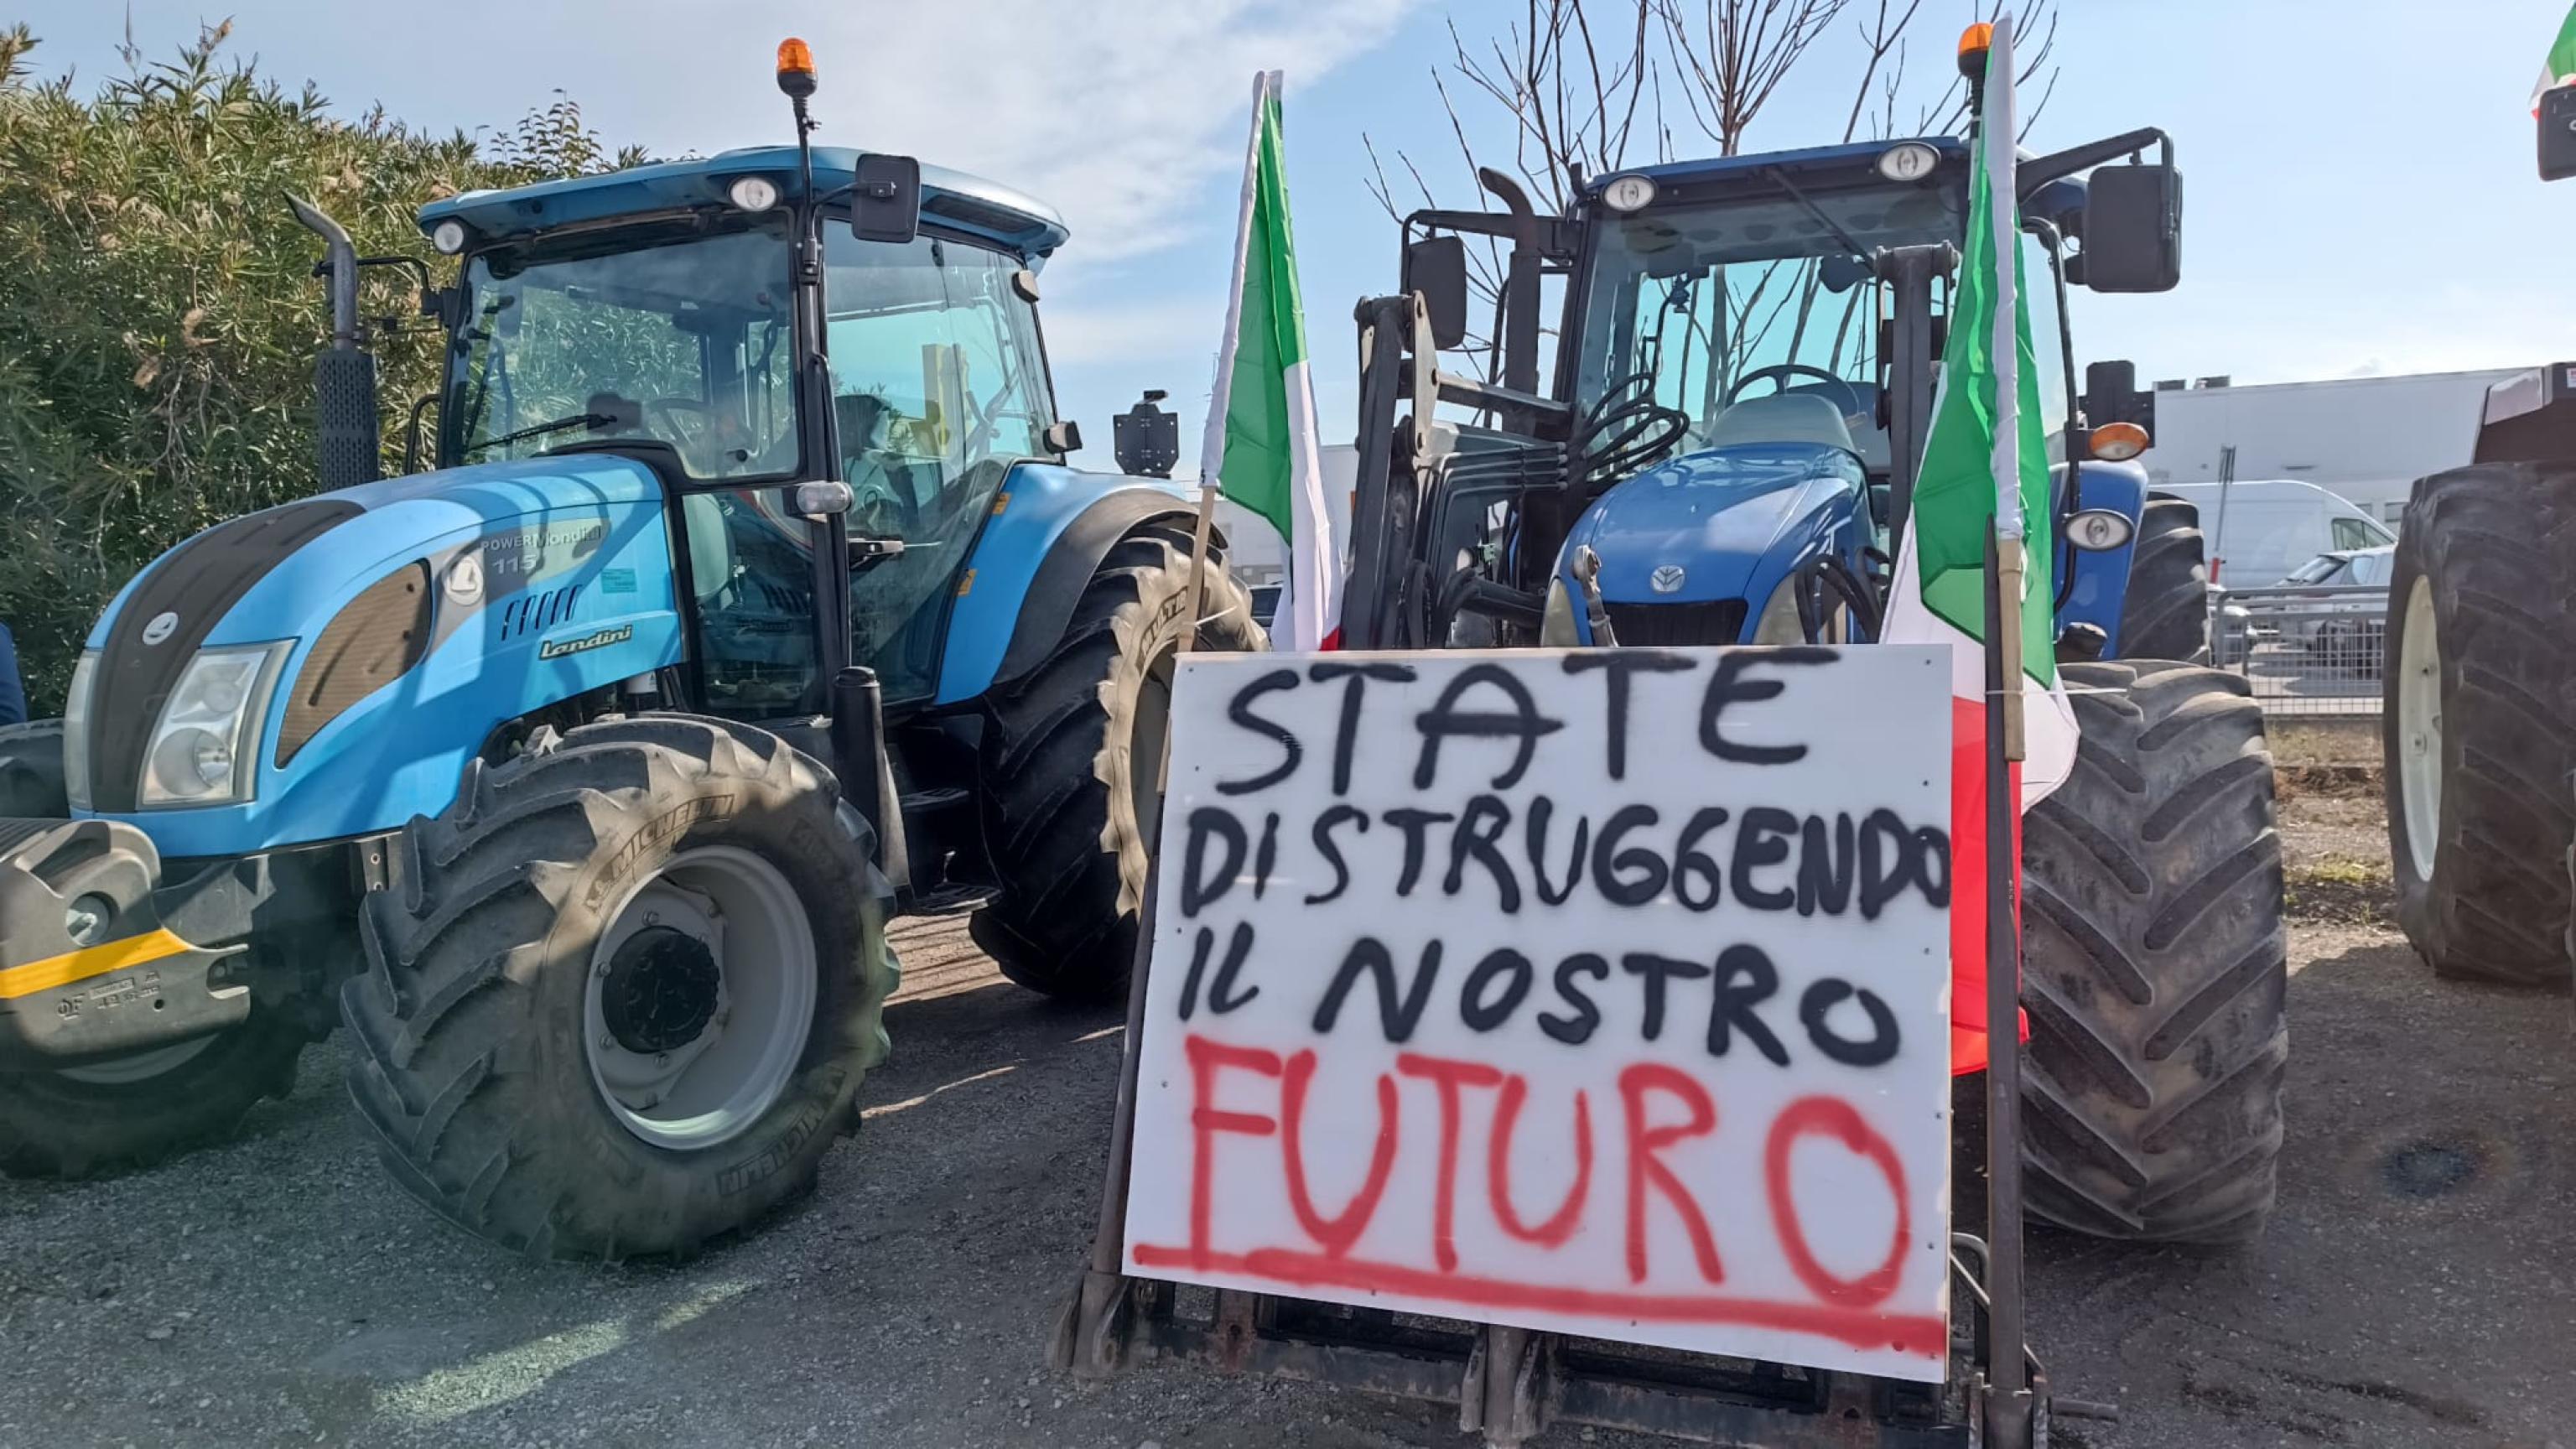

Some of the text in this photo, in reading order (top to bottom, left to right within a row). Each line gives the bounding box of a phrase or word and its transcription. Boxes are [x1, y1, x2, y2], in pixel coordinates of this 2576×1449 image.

[491, 553, 537, 575] 115
[541, 626, 632, 660] Landini
[1216, 646, 1841, 796] STATE
[1180, 793, 1950, 921] DISTRUGGENDO
[1177, 921, 1902, 1068] IL NOSTRO
[1184, 1032, 1912, 1310] FUTURO
